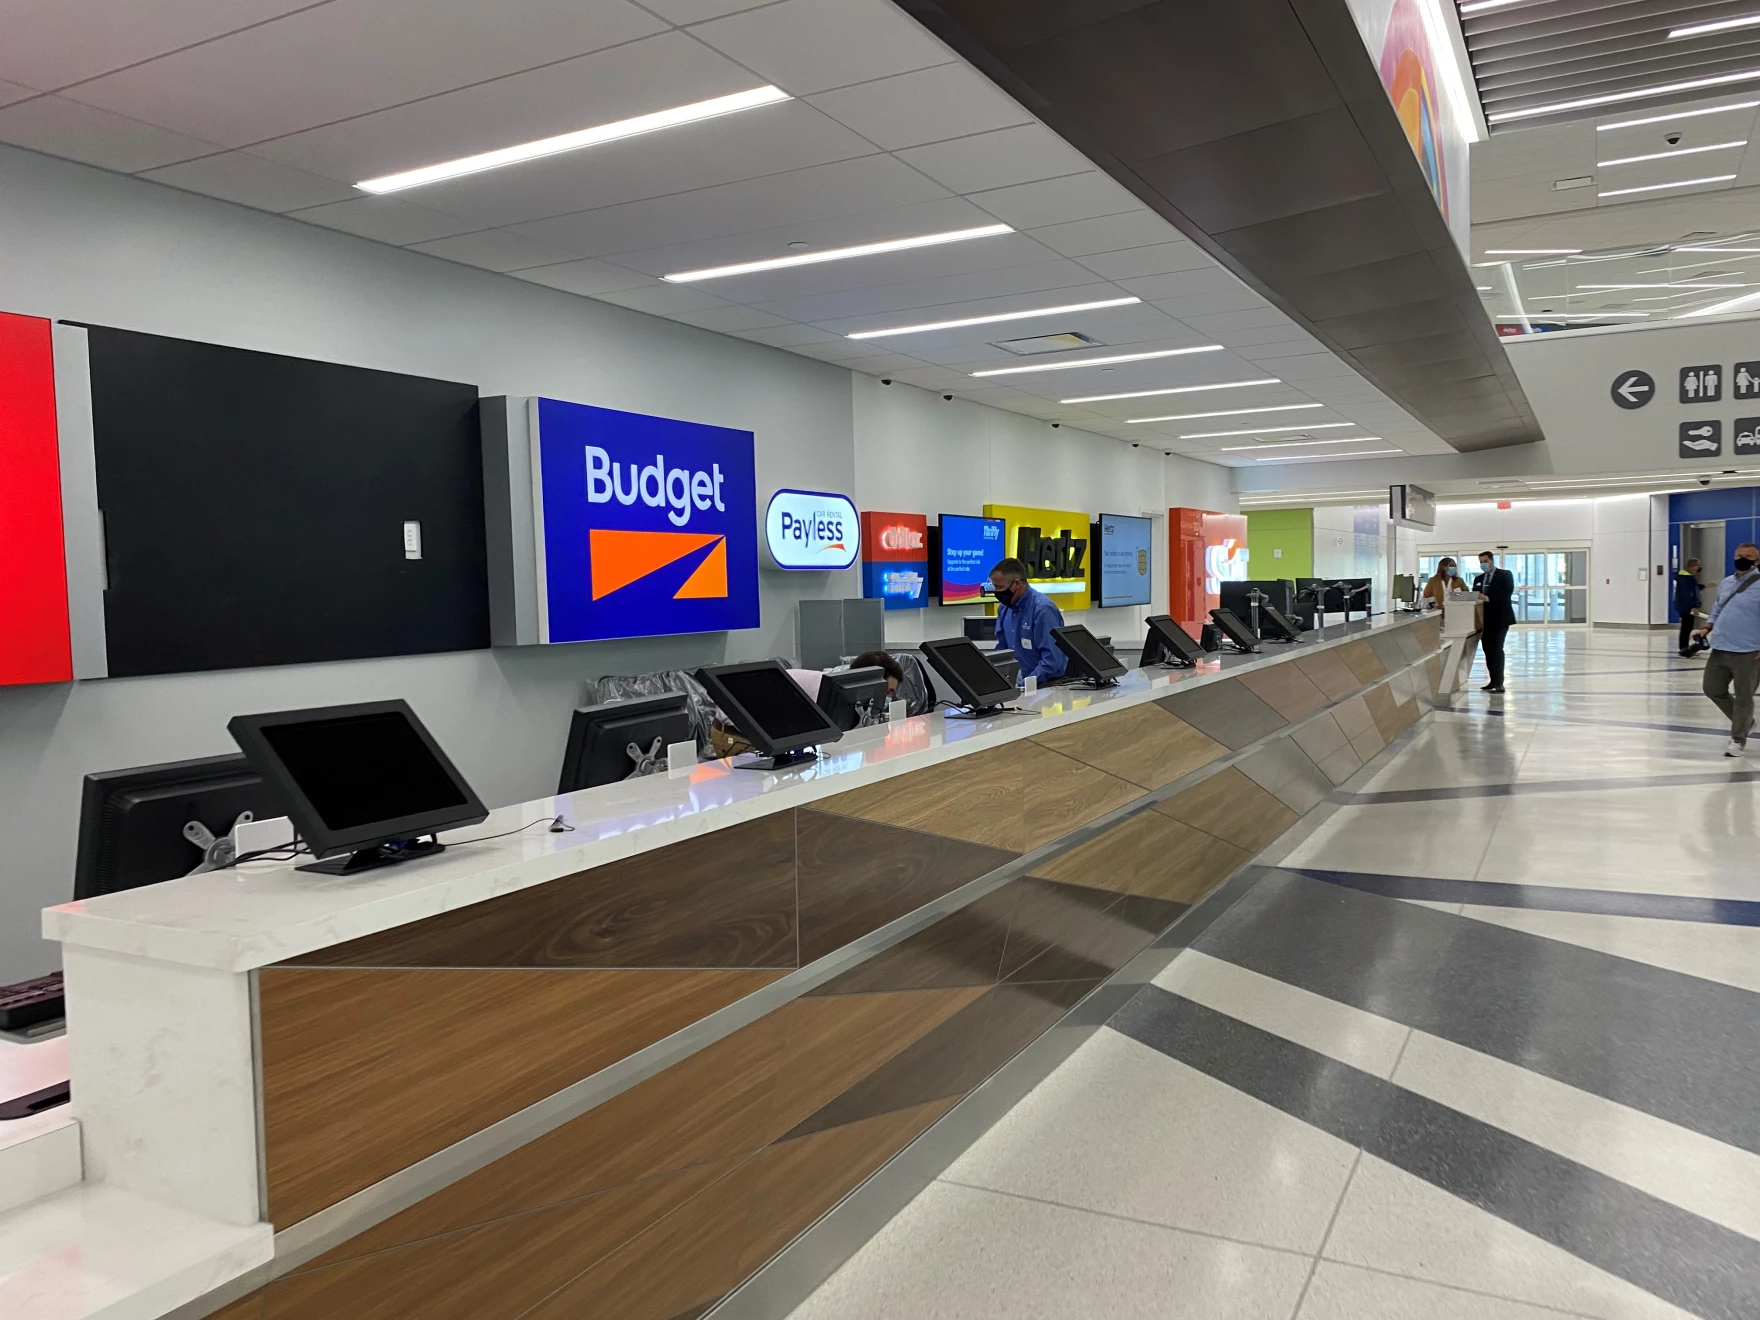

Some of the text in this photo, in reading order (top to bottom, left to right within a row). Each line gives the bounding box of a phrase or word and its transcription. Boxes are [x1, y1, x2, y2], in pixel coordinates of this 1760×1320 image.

[585, 445, 725, 527] Budget
[781, 511, 843, 548] Payless
[827, 511, 843, 519] RENTAL
[1017, 526, 1087, 579] Hertz
